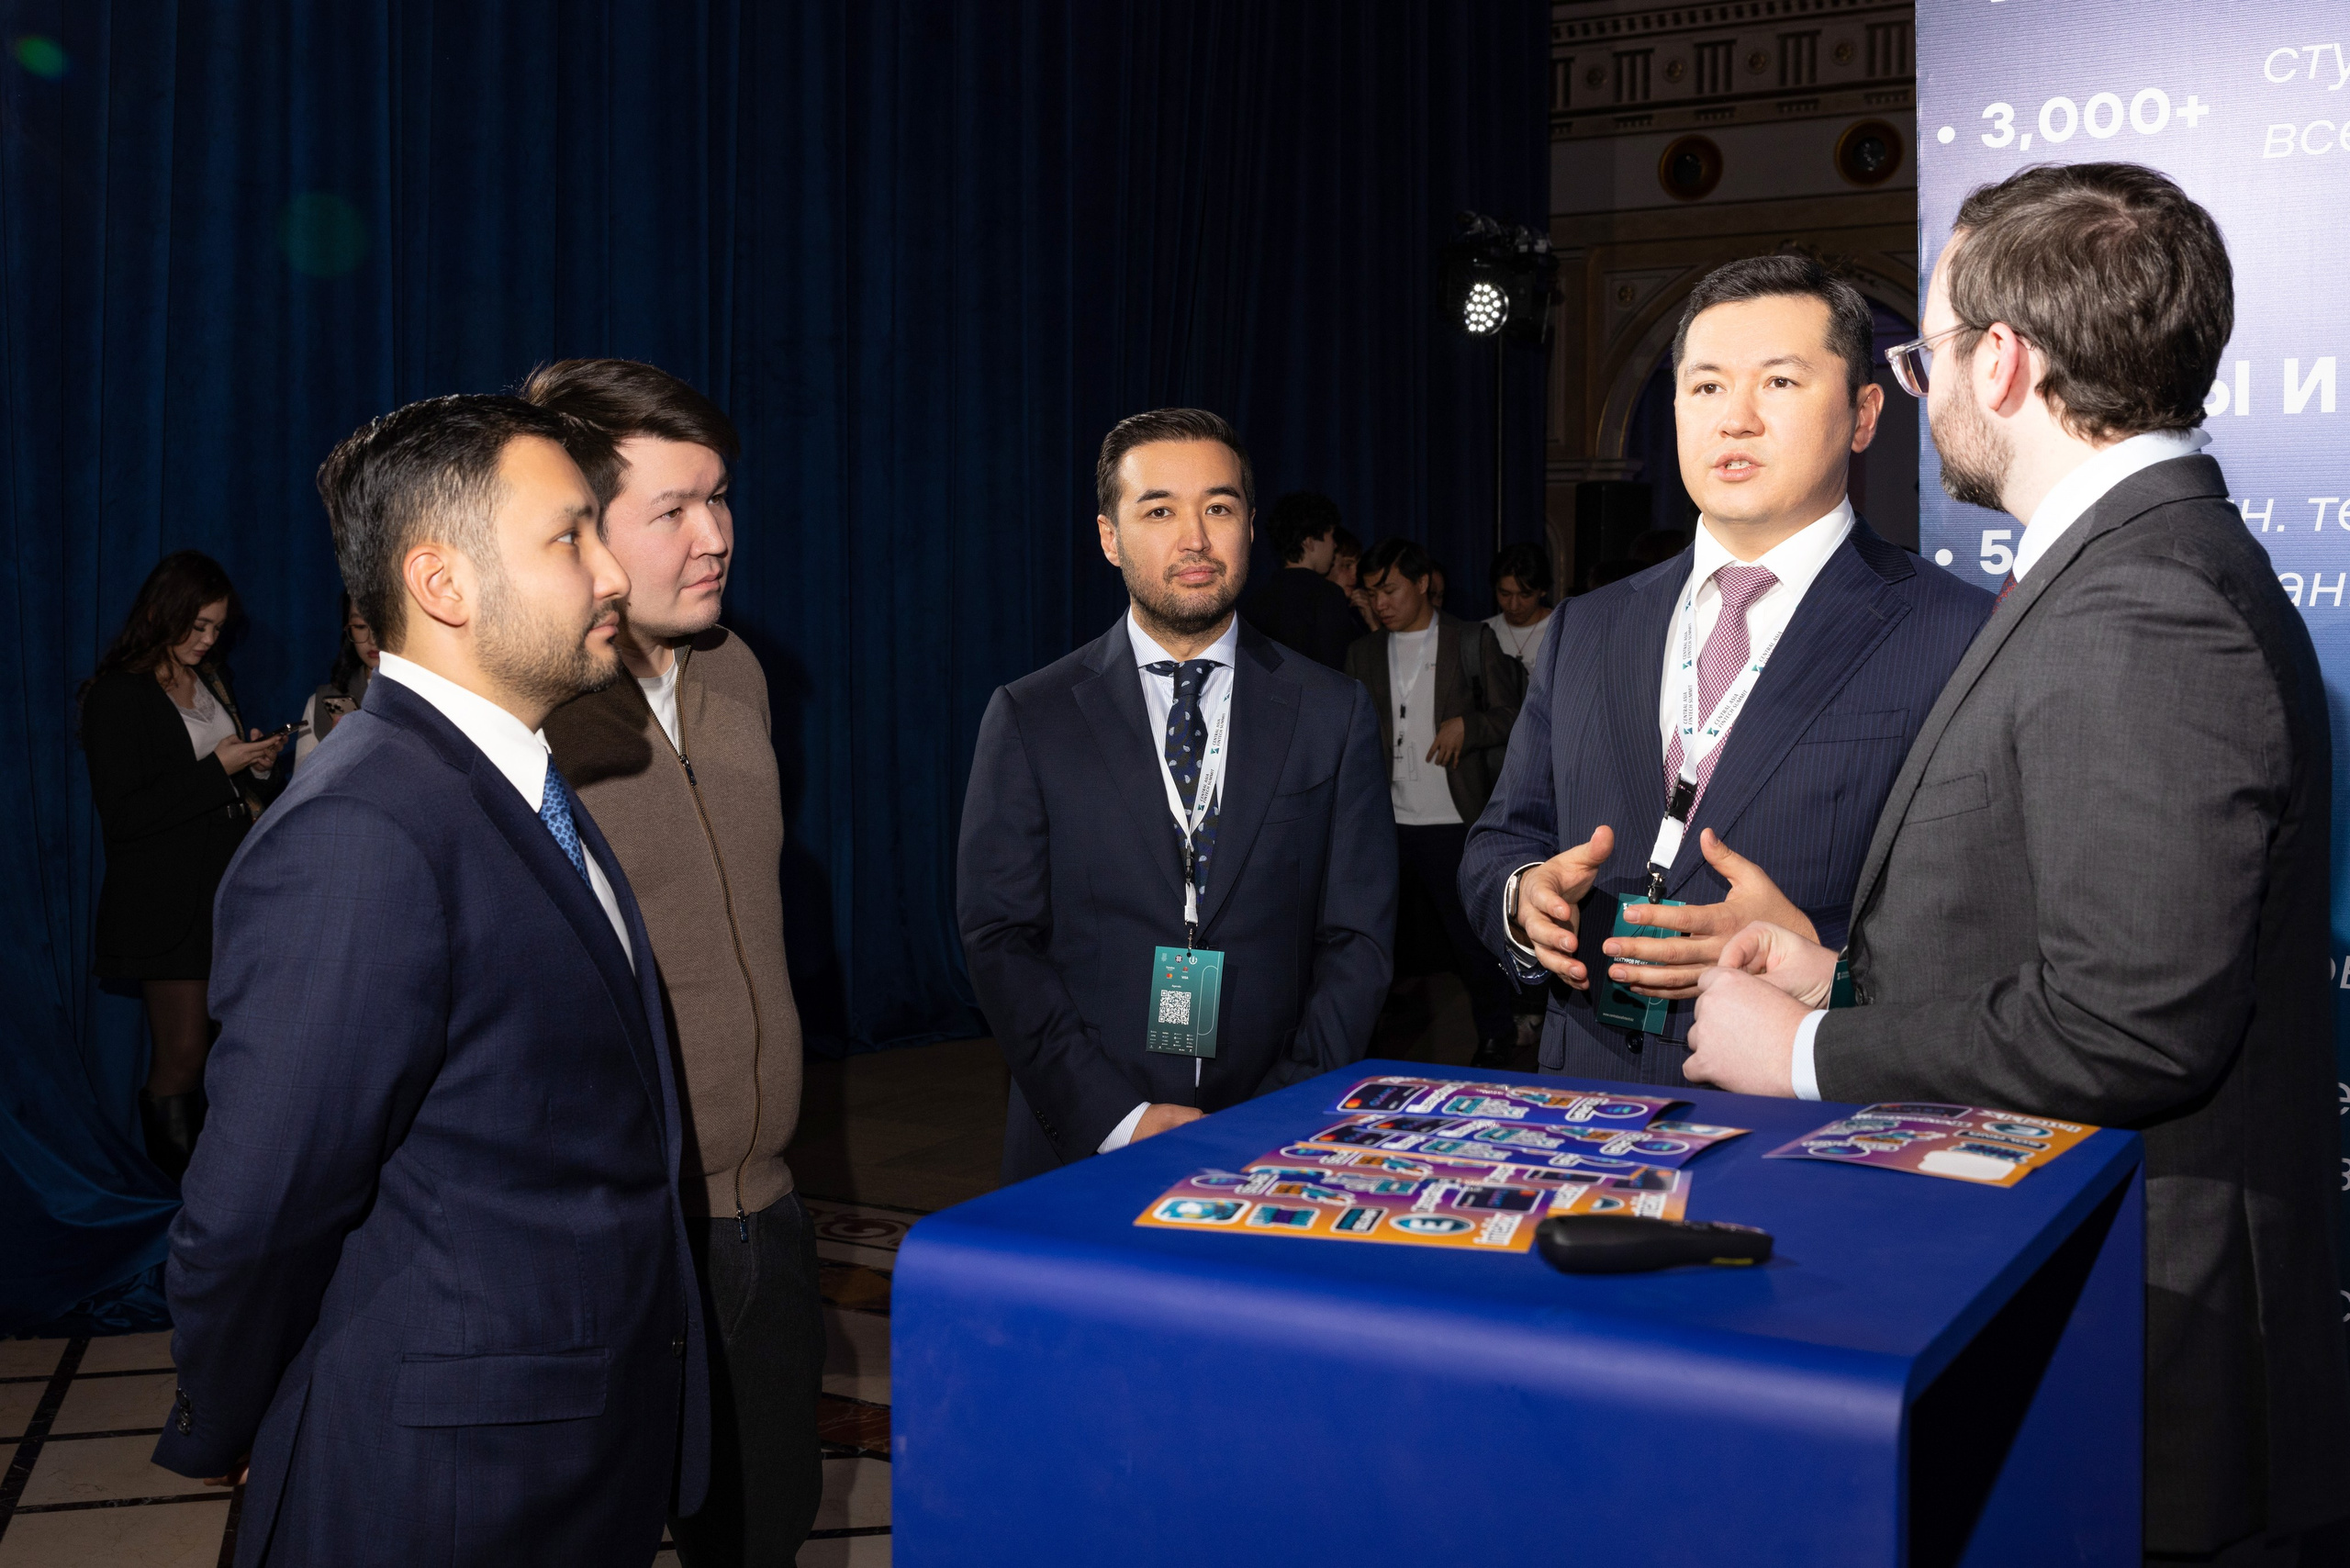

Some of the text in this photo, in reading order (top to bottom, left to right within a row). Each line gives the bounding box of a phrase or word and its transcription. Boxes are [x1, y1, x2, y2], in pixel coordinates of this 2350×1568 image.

[2264, 42, 2350, 91] сту
[1980, 88, 2210, 151] 3,000+
[1979, 530, 2014, 576] 5
